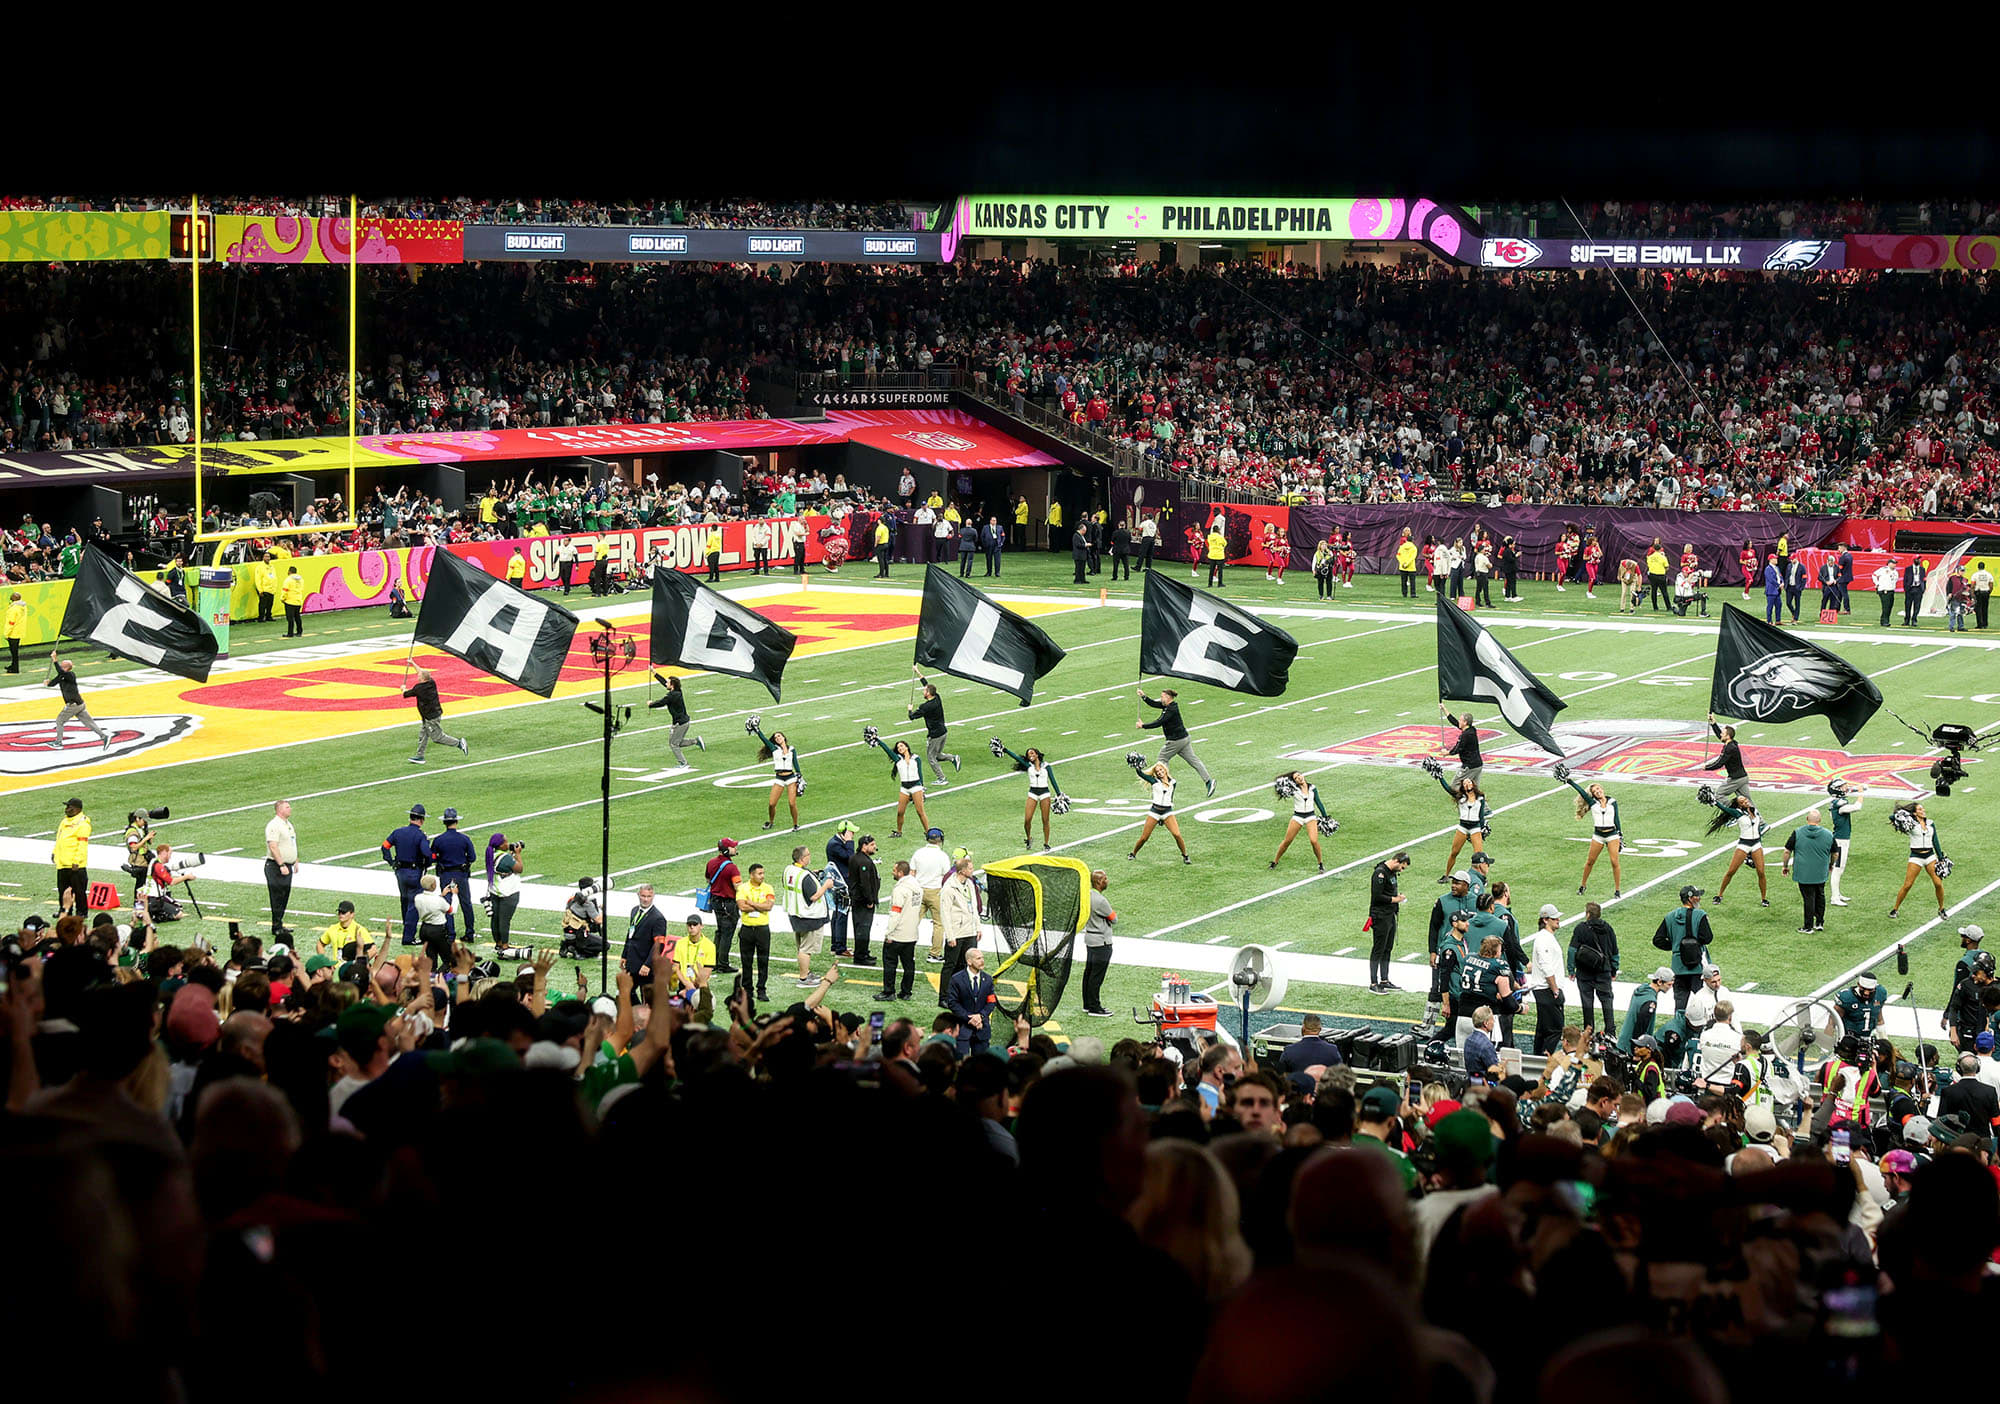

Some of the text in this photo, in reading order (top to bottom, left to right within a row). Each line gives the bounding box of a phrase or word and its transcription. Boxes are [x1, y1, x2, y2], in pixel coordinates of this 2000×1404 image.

[975, 203, 1110, 229] KANSAS CITY
[1162, 205, 1332, 232] PHILADELPHIA
[507, 235, 564, 250] BUD LIGHT
[631, 237, 685, 250] BUD LIGHT
[750, 239, 803, 252] BUD LIGHT
[865, 240, 915, 253] BUD LIGHT
[1570, 244, 1742, 264] SUPER BOWL LIX
[813, 393, 949, 405] CAESARS SUPERDOME
[561, 436, 715, 449] SUPERDOME
[529, 532, 637, 583] SUPER
[643, 526, 741, 570] BOWL
[1822, 611, 1836, 624] 20
[445, 580, 549, 682] A
[678, 585, 768, 672] G
[1171, 588, 1263, 688] E
[948, 599, 1026, 690] L
[90, 885, 110, 907] 10
[1461, 965, 1483, 992] 51
[1861, 1011, 1872, 1032] 1
